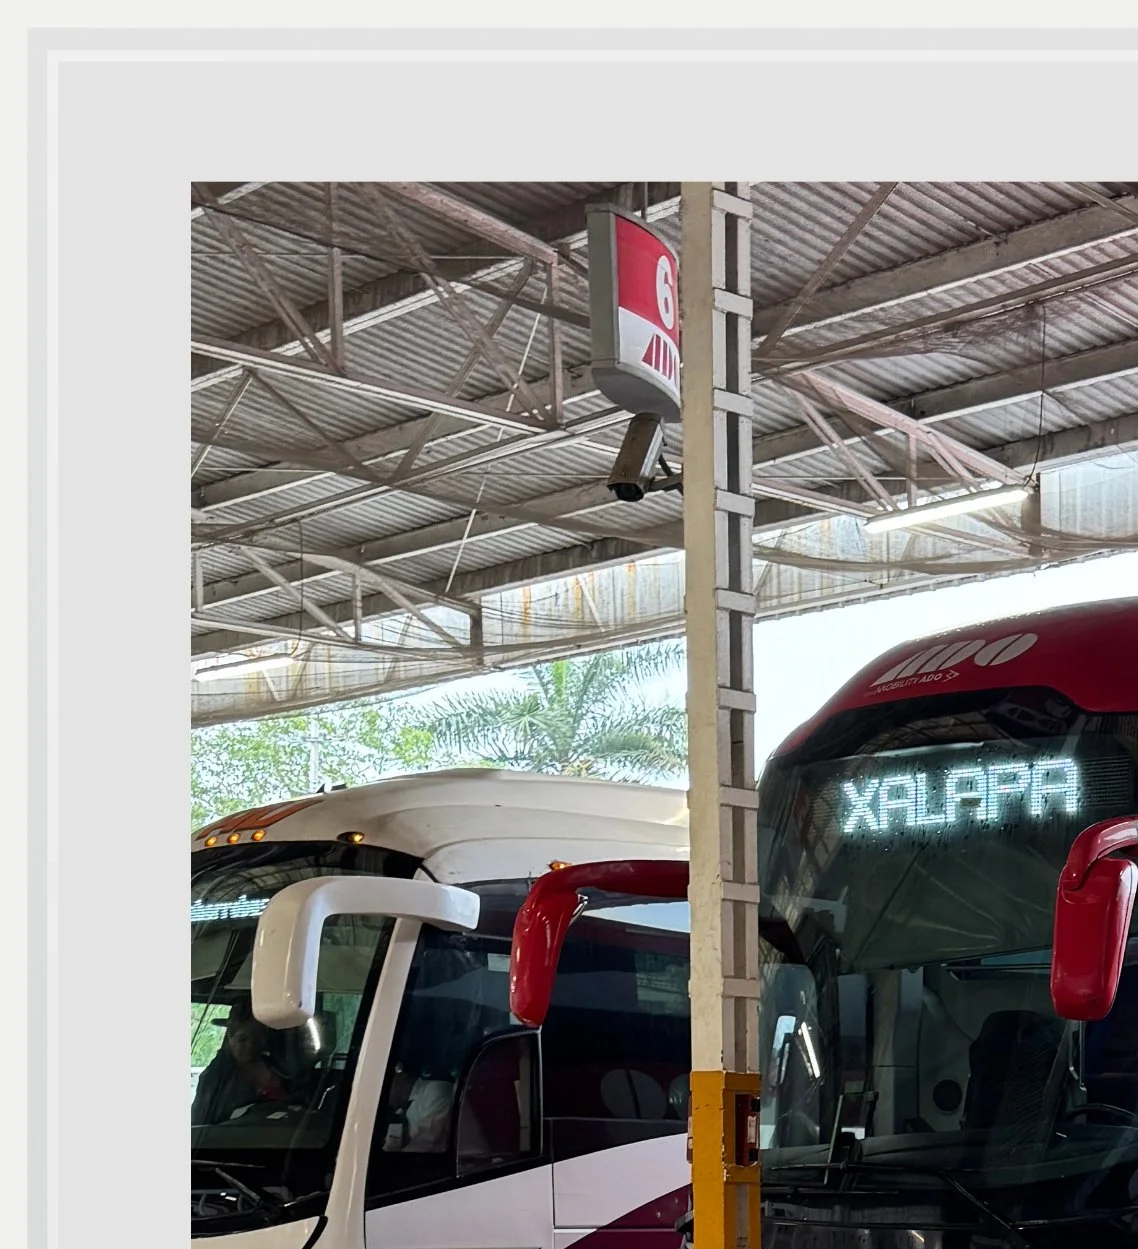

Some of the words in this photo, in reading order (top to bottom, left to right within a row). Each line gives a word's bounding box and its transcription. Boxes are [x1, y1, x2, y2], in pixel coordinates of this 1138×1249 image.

[656, 255, 674, 330] 6
[641, 333, 678, 389] AD
[870, 633, 1038, 687] ADO
[843, 758, 1078, 833] XALAPA
